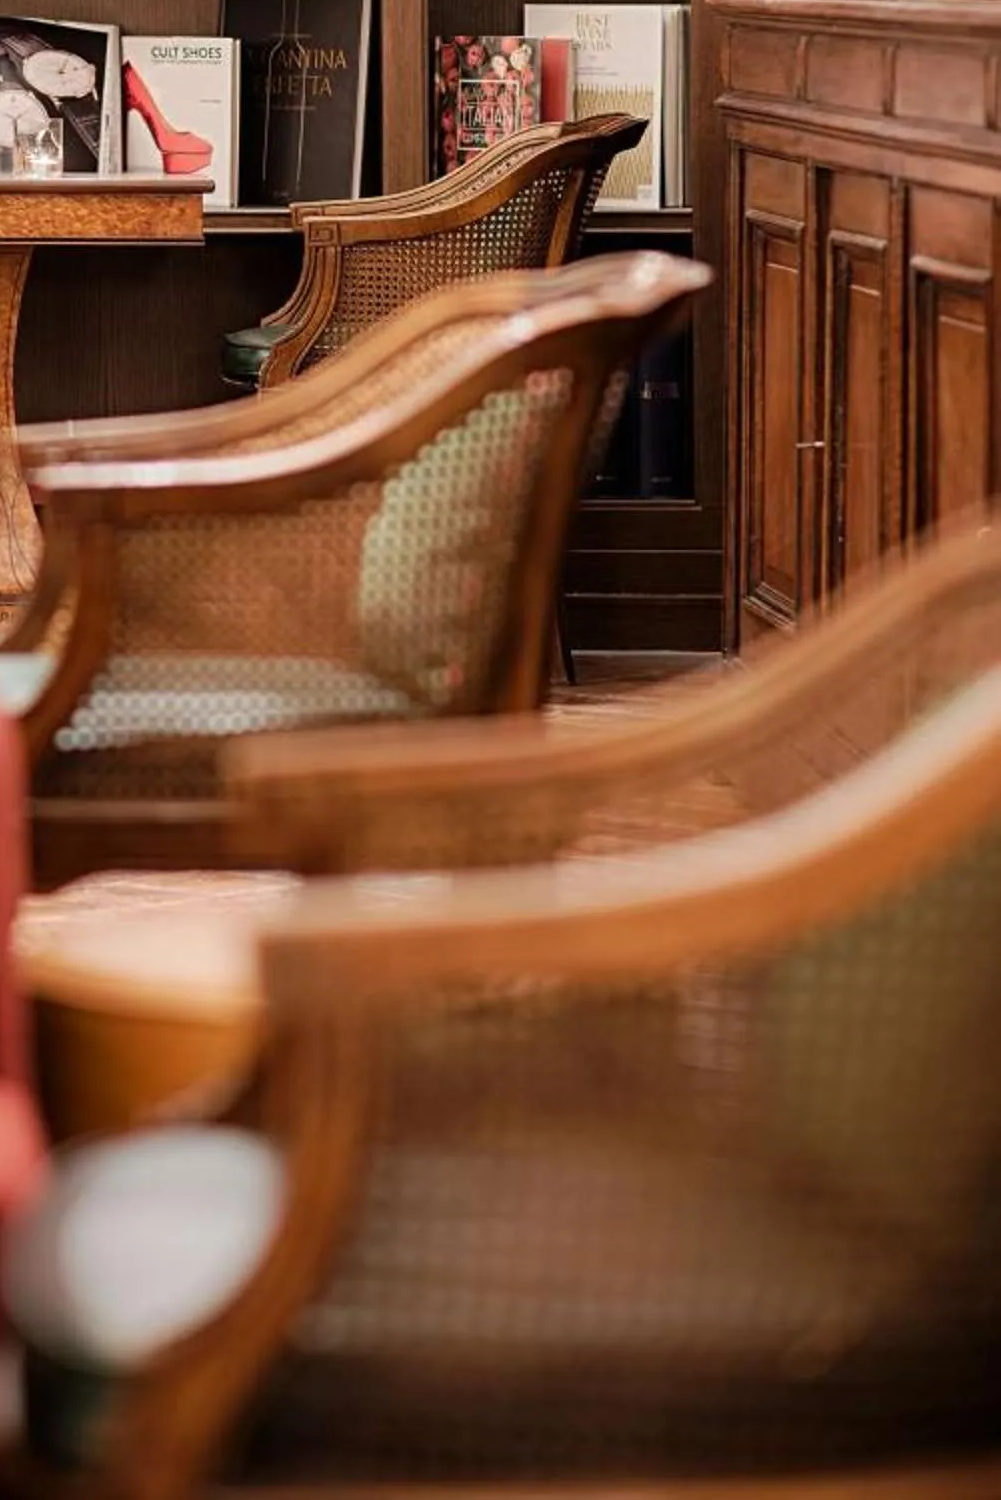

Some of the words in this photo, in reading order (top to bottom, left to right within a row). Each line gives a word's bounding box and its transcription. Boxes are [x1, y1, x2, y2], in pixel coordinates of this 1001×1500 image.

[150, 46, 179, 59] CULT
[182, 47, 222, 59] SHOES
[270, 48, 347, 70] ANTINA
